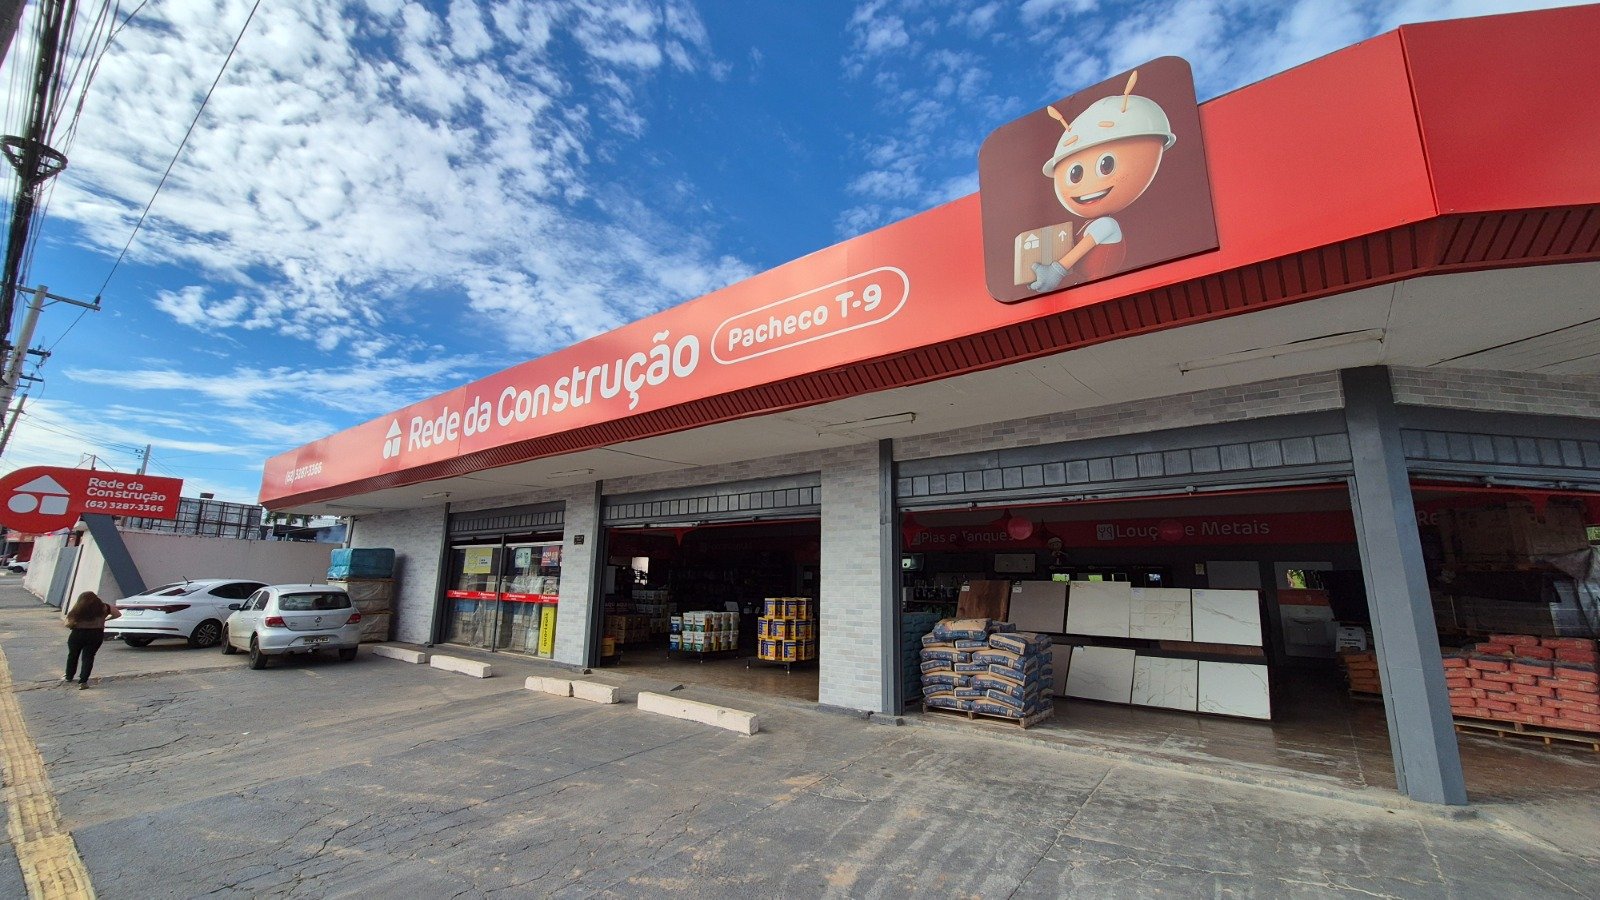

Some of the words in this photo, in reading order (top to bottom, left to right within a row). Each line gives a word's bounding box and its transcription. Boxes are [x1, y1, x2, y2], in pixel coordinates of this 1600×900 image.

[728, 305, 828, 352] Pacheco
[835, 283, 882, 318] T-9
[408, 405, 459, 453] Rede
[464, 396, 491, 437] da
[497, 329, 700, 410] Construção
[88, 477, 125, 489] Rede
[127, 481, 144, 490] da
[86, 487, 167, 503] Construção
[85, 499, 107, 510] (62)
[109, 502, 164, 512] 3287-3366
[922, 532, 946, 543] Pias
[949, 533, 957, 542] e
[1117, 524, 1165, 541] Louç
[1185, 525, 1195, 536] e
[1202, 519, 1271, 536] Metais
